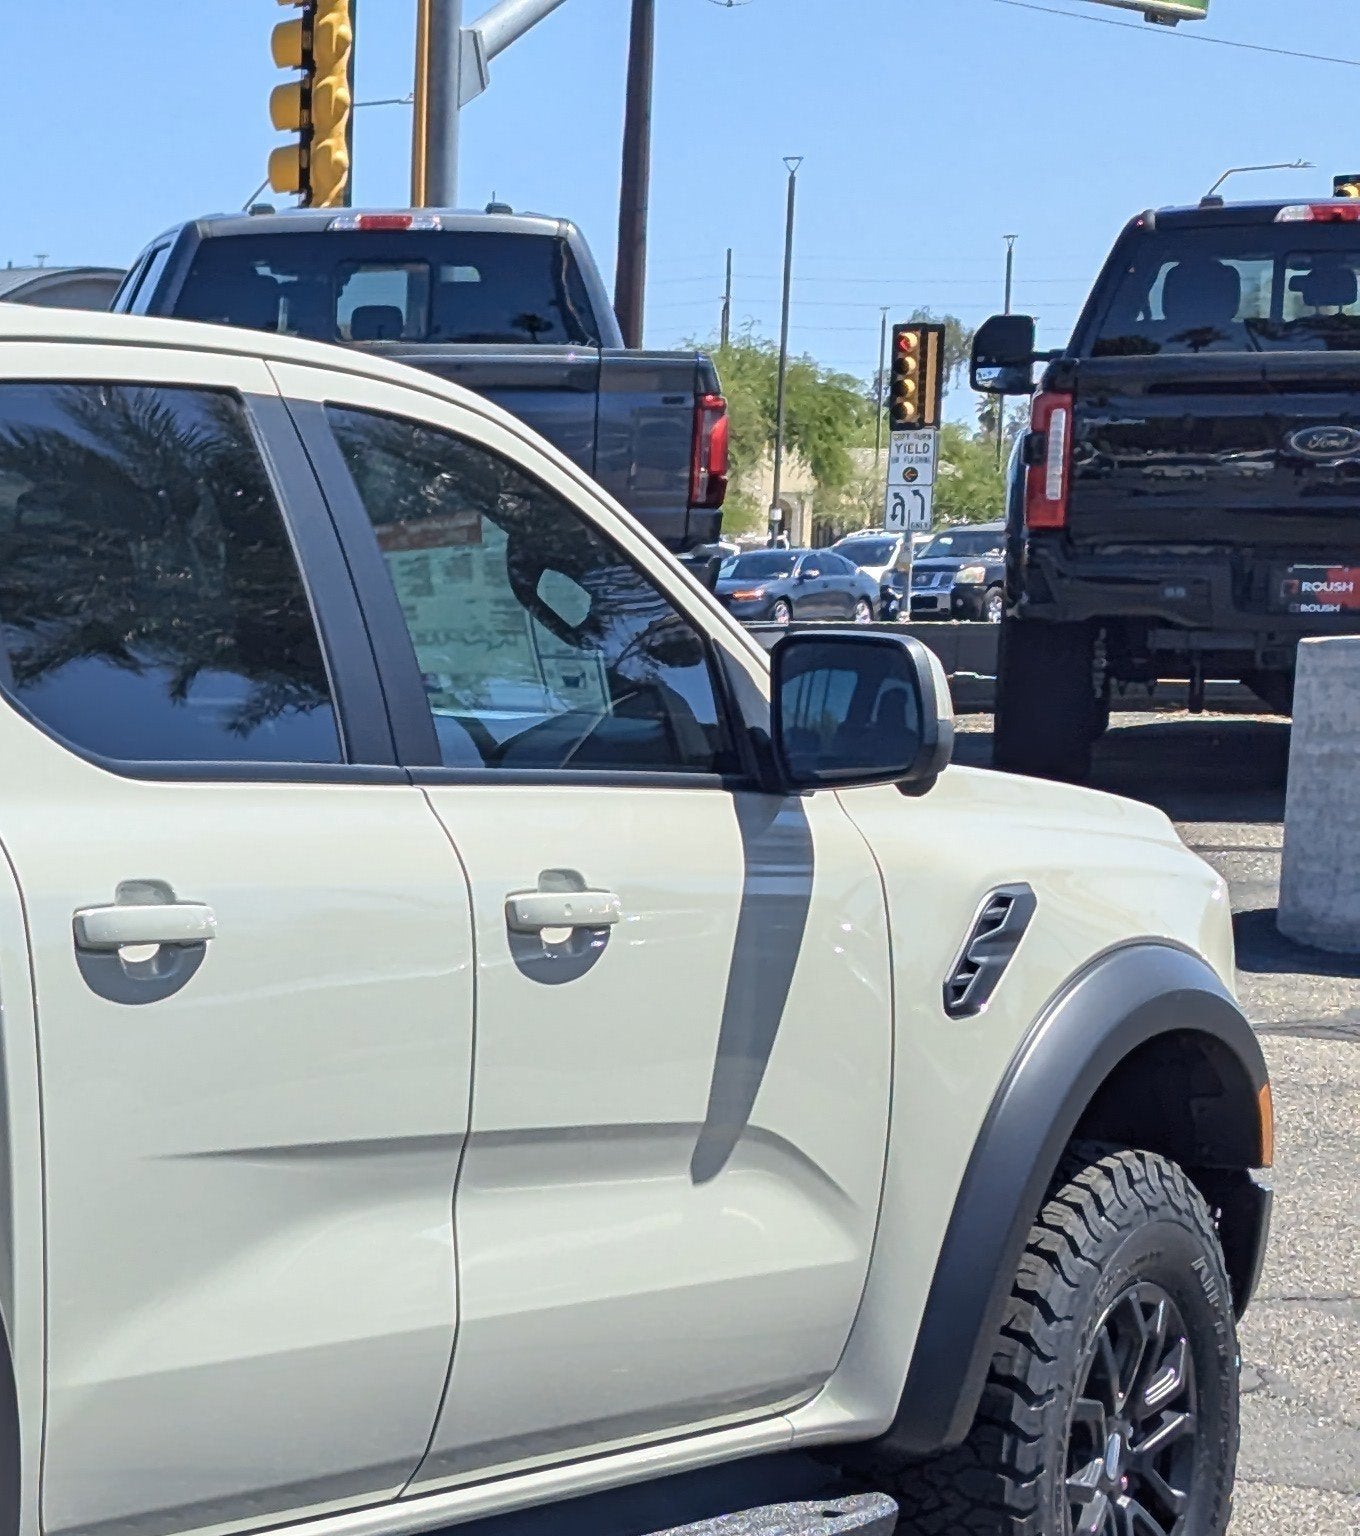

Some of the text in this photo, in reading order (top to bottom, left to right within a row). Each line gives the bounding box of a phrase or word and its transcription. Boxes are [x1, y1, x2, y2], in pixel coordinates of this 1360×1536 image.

[1306, 432, 1351, 450] Ford
[895, 442, 930, 455] YIELD
[1301, 580, 1354, 593] ROUSH
[1300, 602, 1341, 613] ROUSH
